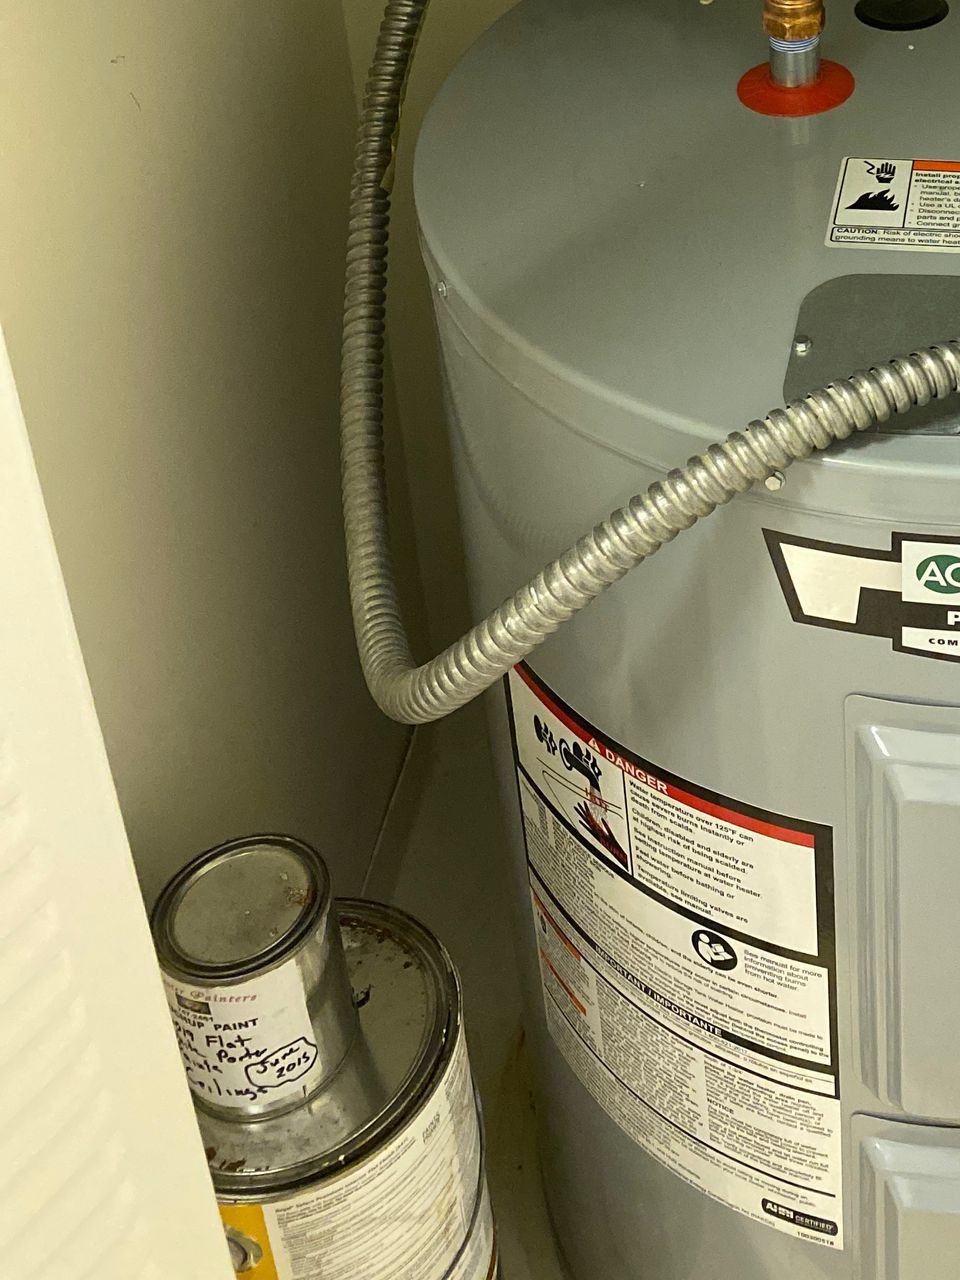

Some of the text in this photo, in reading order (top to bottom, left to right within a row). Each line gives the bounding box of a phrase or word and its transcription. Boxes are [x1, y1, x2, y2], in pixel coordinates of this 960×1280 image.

[605, 748, 669, 795] DANGER
[629, 780, 649, 794] Water
[650, 793, 694, 818] temperature
[695, 816, 713, 826] over
[738, 834, 754, 842] can
[629, 789, 650, 804] cause
[651, 801, 675, 817] severe
[676, 814, 699, 828] burns
[700, 824, 734, 843] instantly
[630, 796, 650, 811] death
[651, 808, 668, 821] from
[633, 827, 742, 883] See instruction manual before
[640, 819, 666, 838] highest
[667, 834, 681, 846] risk
[682, 842, 691, 851] of
[691, 847, 714, 862] being
[664, 827, 695, 845] disabled
[696, 842, 711, 853] and
[712, 849, 739, 864] elderly
[741, 860, 754, 869] are
[634, 835, 657, 853] setting
[658, 849, 702, 875] temperature
[713, 875, 734, 888] water
[635, 845, 650, 858] Feel
[651, 856, 670, 869] water
[671, 866, 694, 882] before
[696, 880, 725, 897] bathing
[637, 864, 748, 924] Temperature limiting valves are
[670, 892, 683, 902] see
[743, 949, 759, 959] See
[760, 956, 788, 969] manual
[801, 968, 823, 978] more
[743, 956, 809, 981] information about
[744, 963, 807, 987] preventing burns
[744, 968, 761, 979] from
[762, 976, 775, 984] hot
[595, 944, 648, 995] IMPORTANT
[653, 992, 723, 1038] IMPORTANTE
[205, 1034, 252, 1049] Flat
[213, 1017, 259, 1032] PAINT
[276, 1051, 310, 1079] 2015
[706, 1097, 735, 1115] NOTICE
